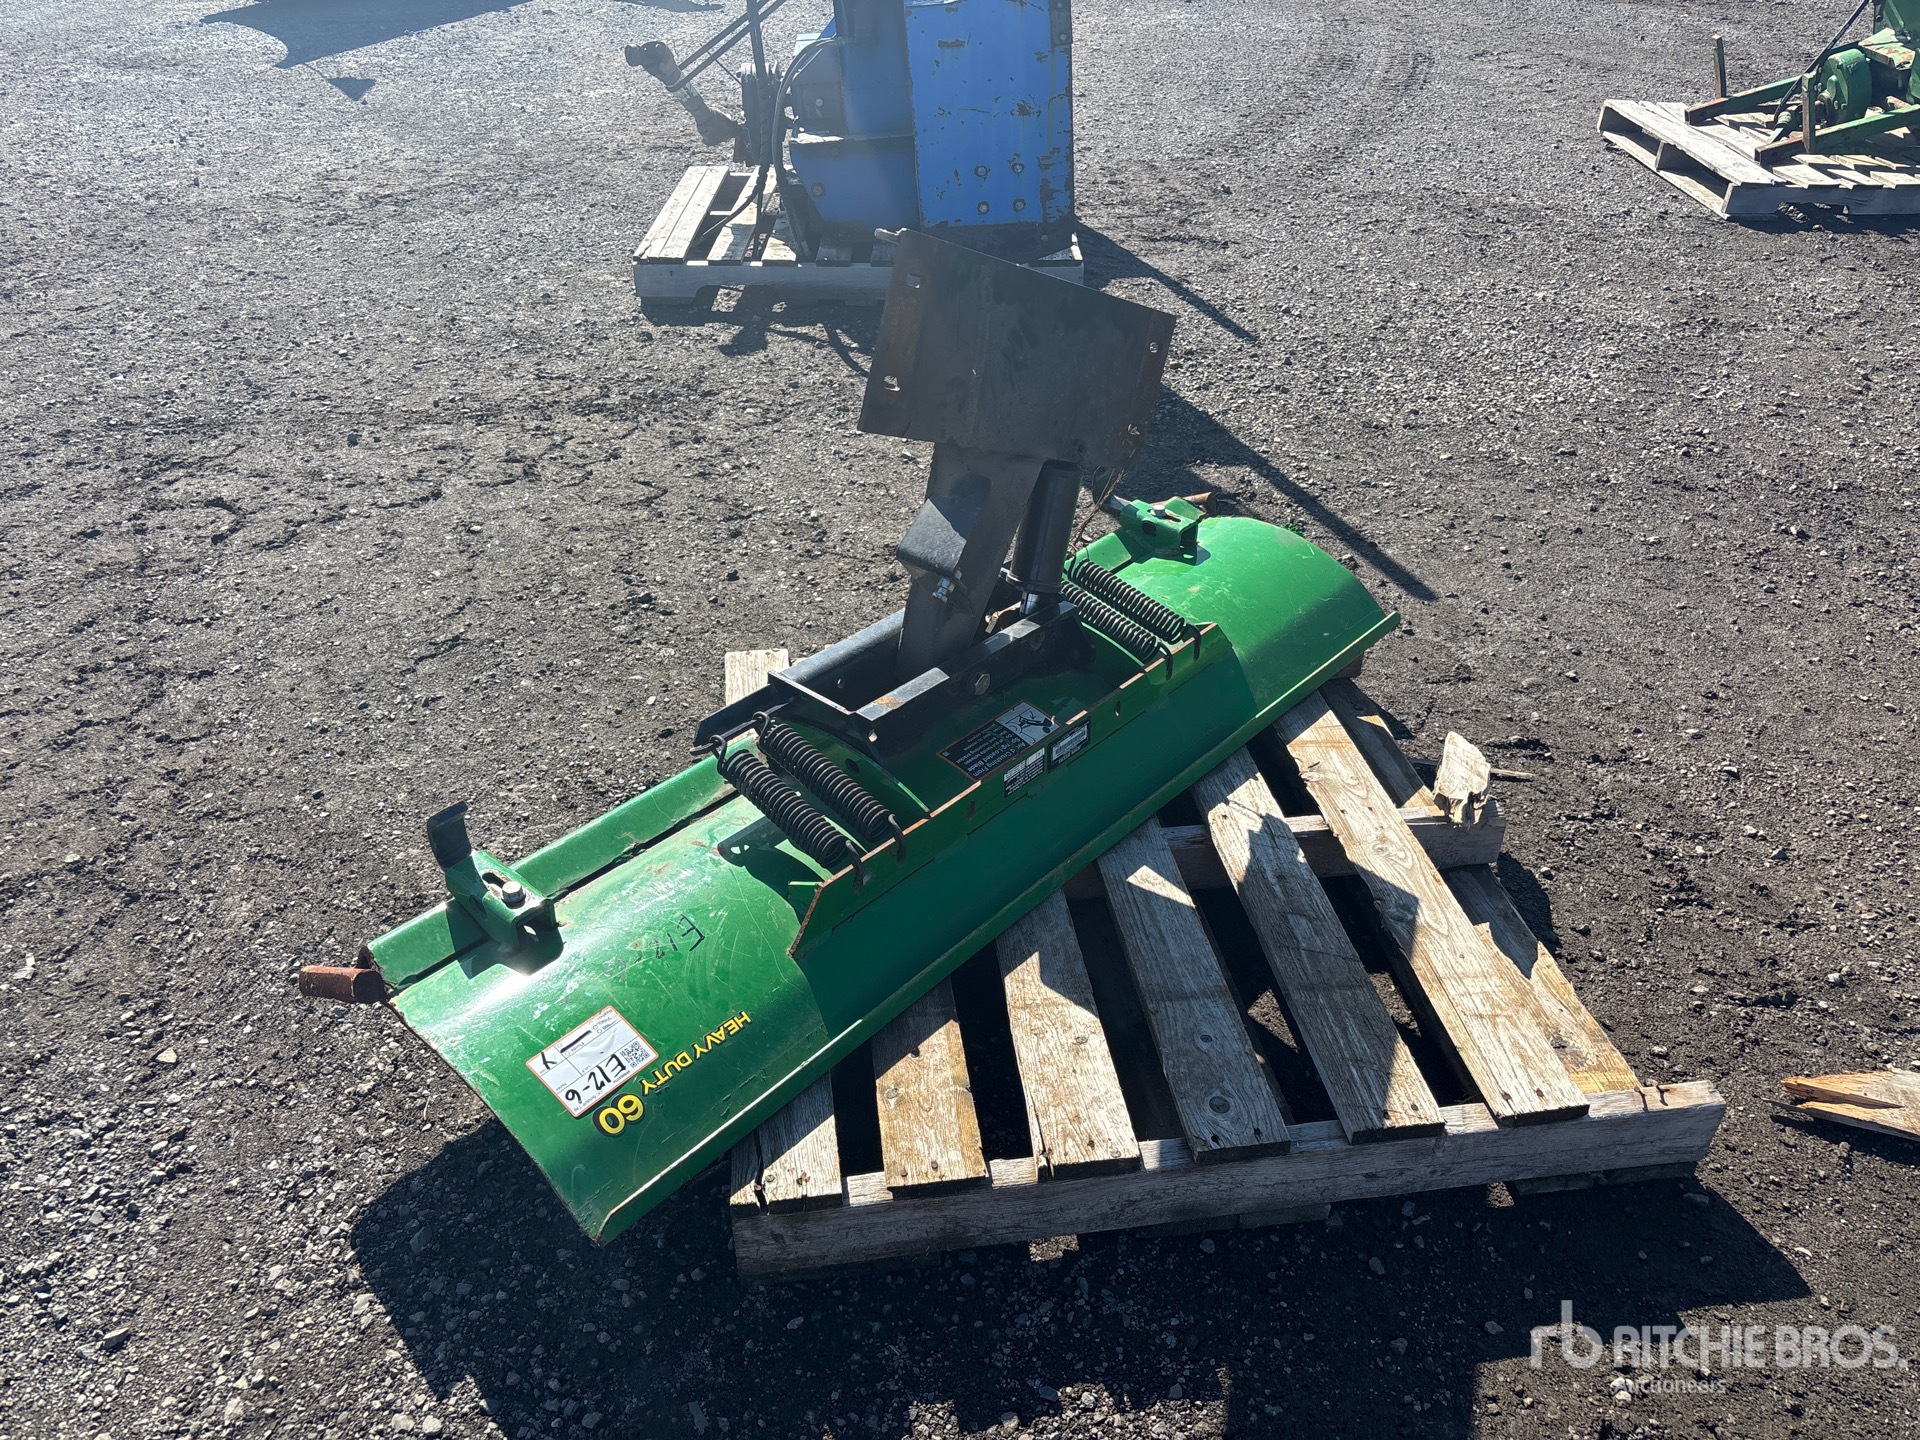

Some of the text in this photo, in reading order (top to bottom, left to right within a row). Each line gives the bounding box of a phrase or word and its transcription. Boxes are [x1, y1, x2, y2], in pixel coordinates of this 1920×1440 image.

[966, 759, 984, 772] Blade
[972, 740, 1025, 777] Avod Crushing From
[981, 737, 1020, 763] Spng-Loaded
[641, 1011, 752, 1096] HEAVY DUTY
[565, 1054, 627, 1104] E12-6
[593, 1093, 645, 1136] 60
